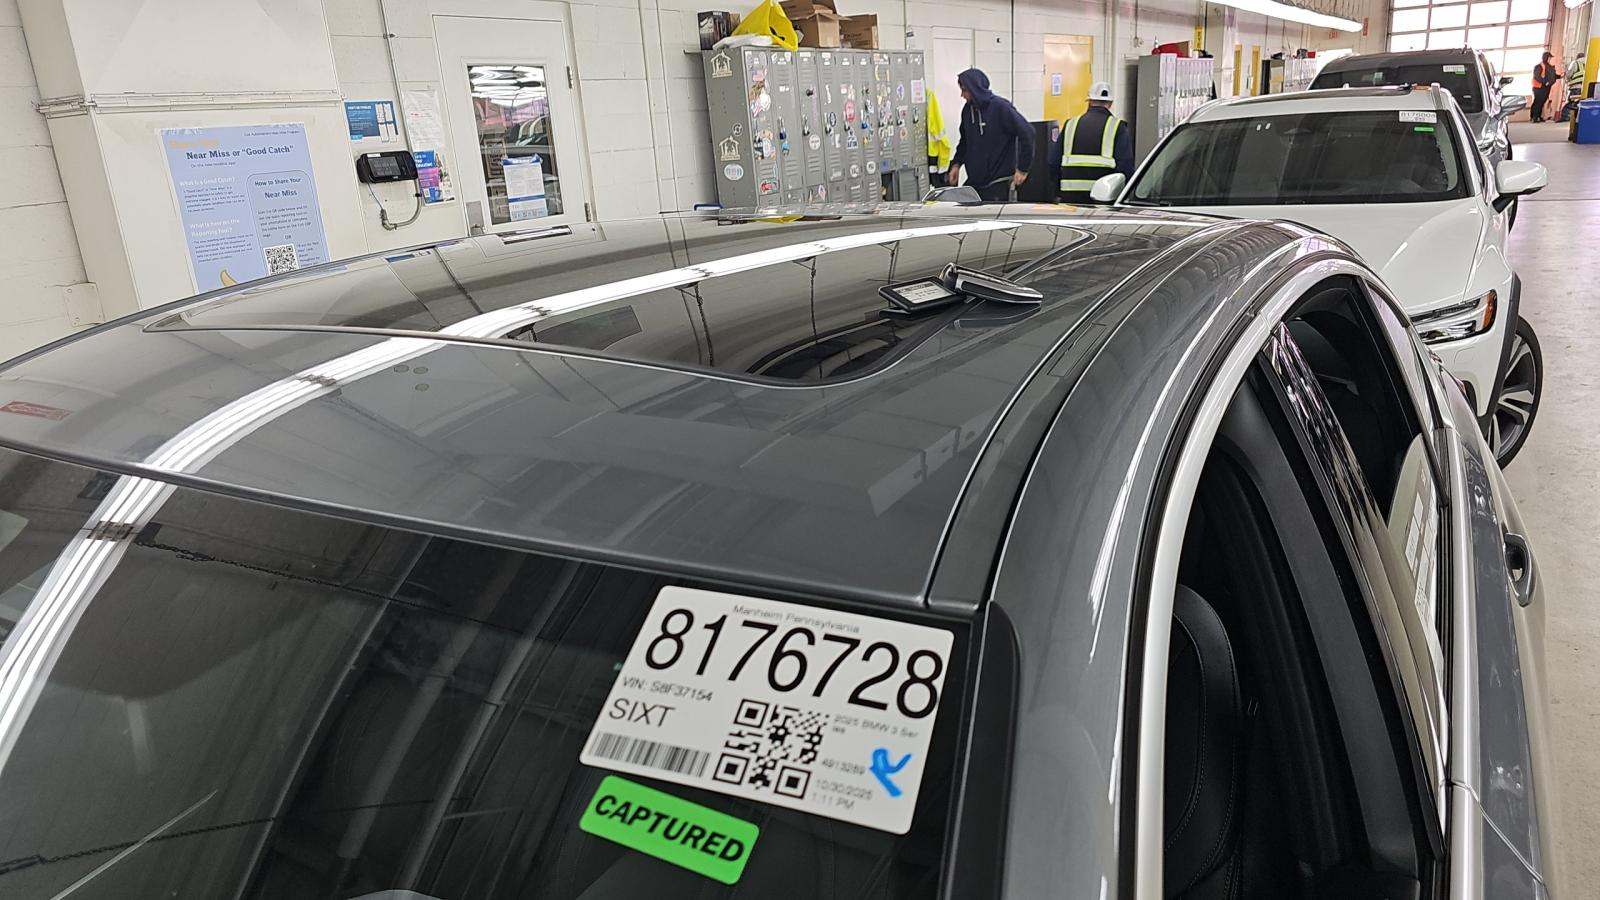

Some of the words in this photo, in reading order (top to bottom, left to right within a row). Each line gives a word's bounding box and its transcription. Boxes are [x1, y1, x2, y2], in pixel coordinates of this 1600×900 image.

[186, 151, 207, 160] Near
[209, 149, 230, 158] Miss
[241, 146, 267, 156] "Good
[268, 145, 294, 154] Catch"
[254, 180, 267, 188] How
[264, 191, 280, 199] Near
[281, 189, 298, 197] Miss
[733, 604, 783, 621] Manheim
[786, 611, 861, 634] Pennsylvania
[645, 608, 944, 719] 8176728
[623, 676, 648, 690] VIN:
[609, 698, 676, 728] SIXT
[834, 715, 860, 727] 2025
[861, 719, 889, 733] BMW
[890, 726, 898, 735] 3
[900, 727, 919, 738] Ser
[836, 797, 855, 809] PM
[595, 795, 745, 862] CAPTURED
